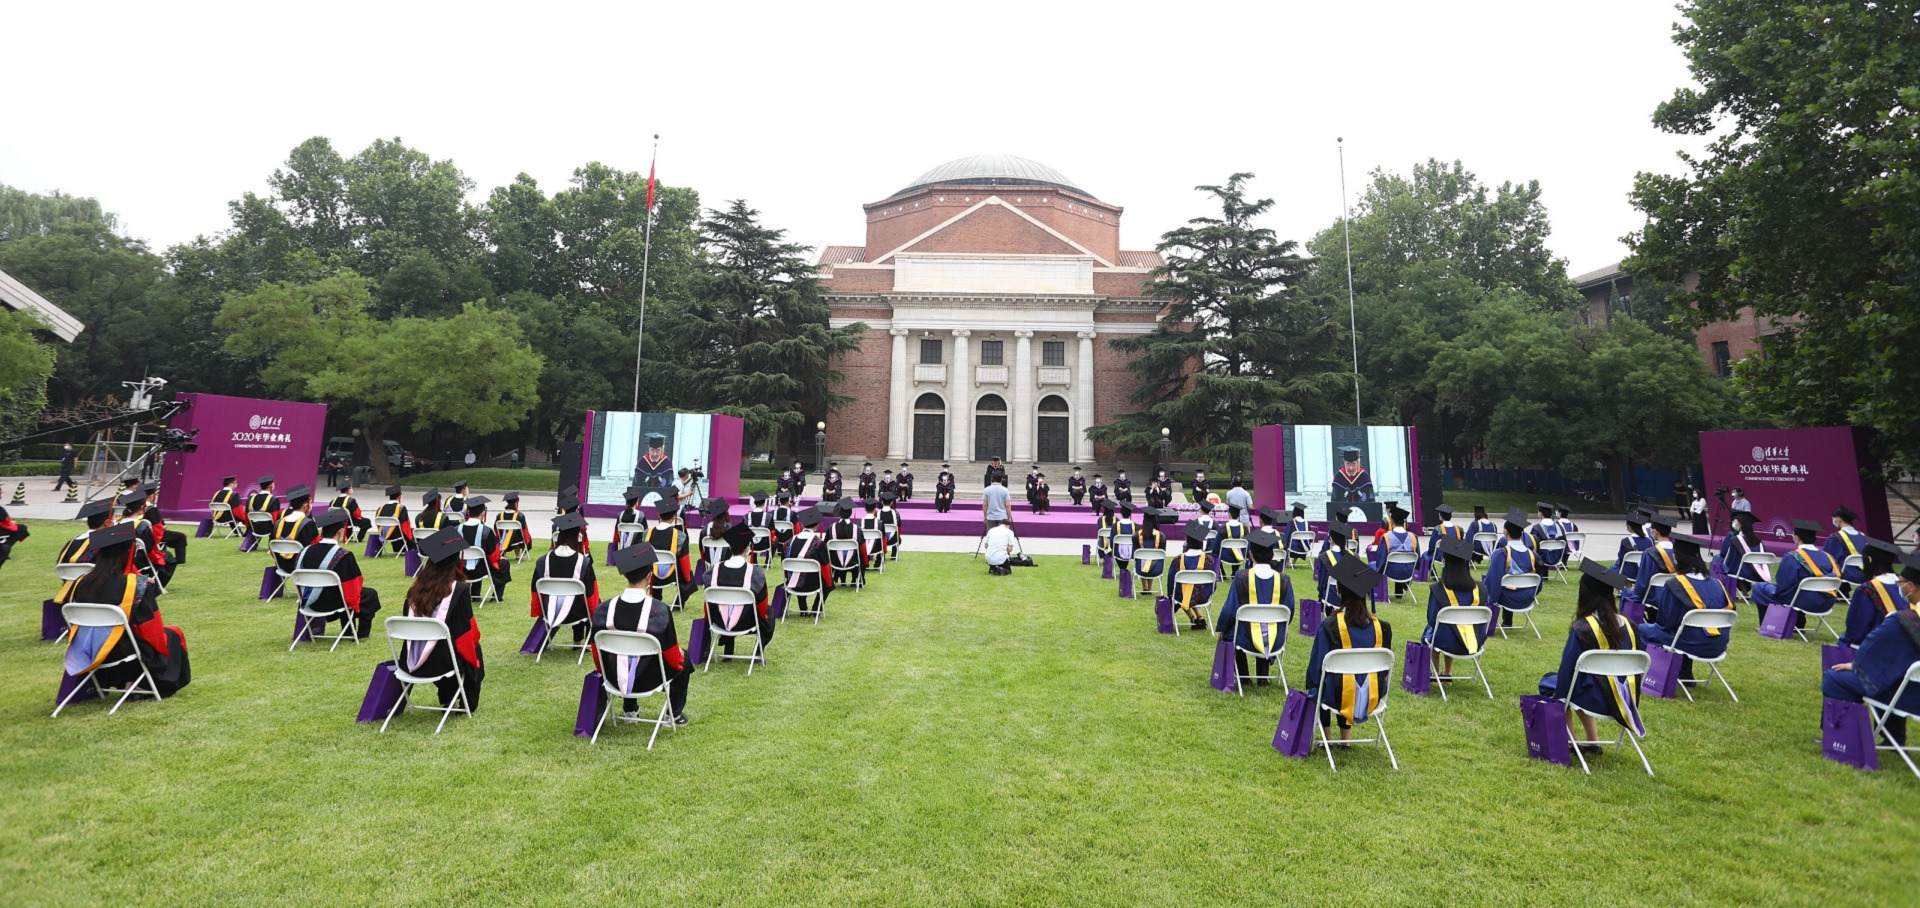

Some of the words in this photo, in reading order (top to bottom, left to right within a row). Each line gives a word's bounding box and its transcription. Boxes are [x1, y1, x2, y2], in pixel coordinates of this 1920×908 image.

[232, 432, 292, 442] 2020年毕业典礼
[1739, 464, 1809, 475] 2020年毕业典礼
